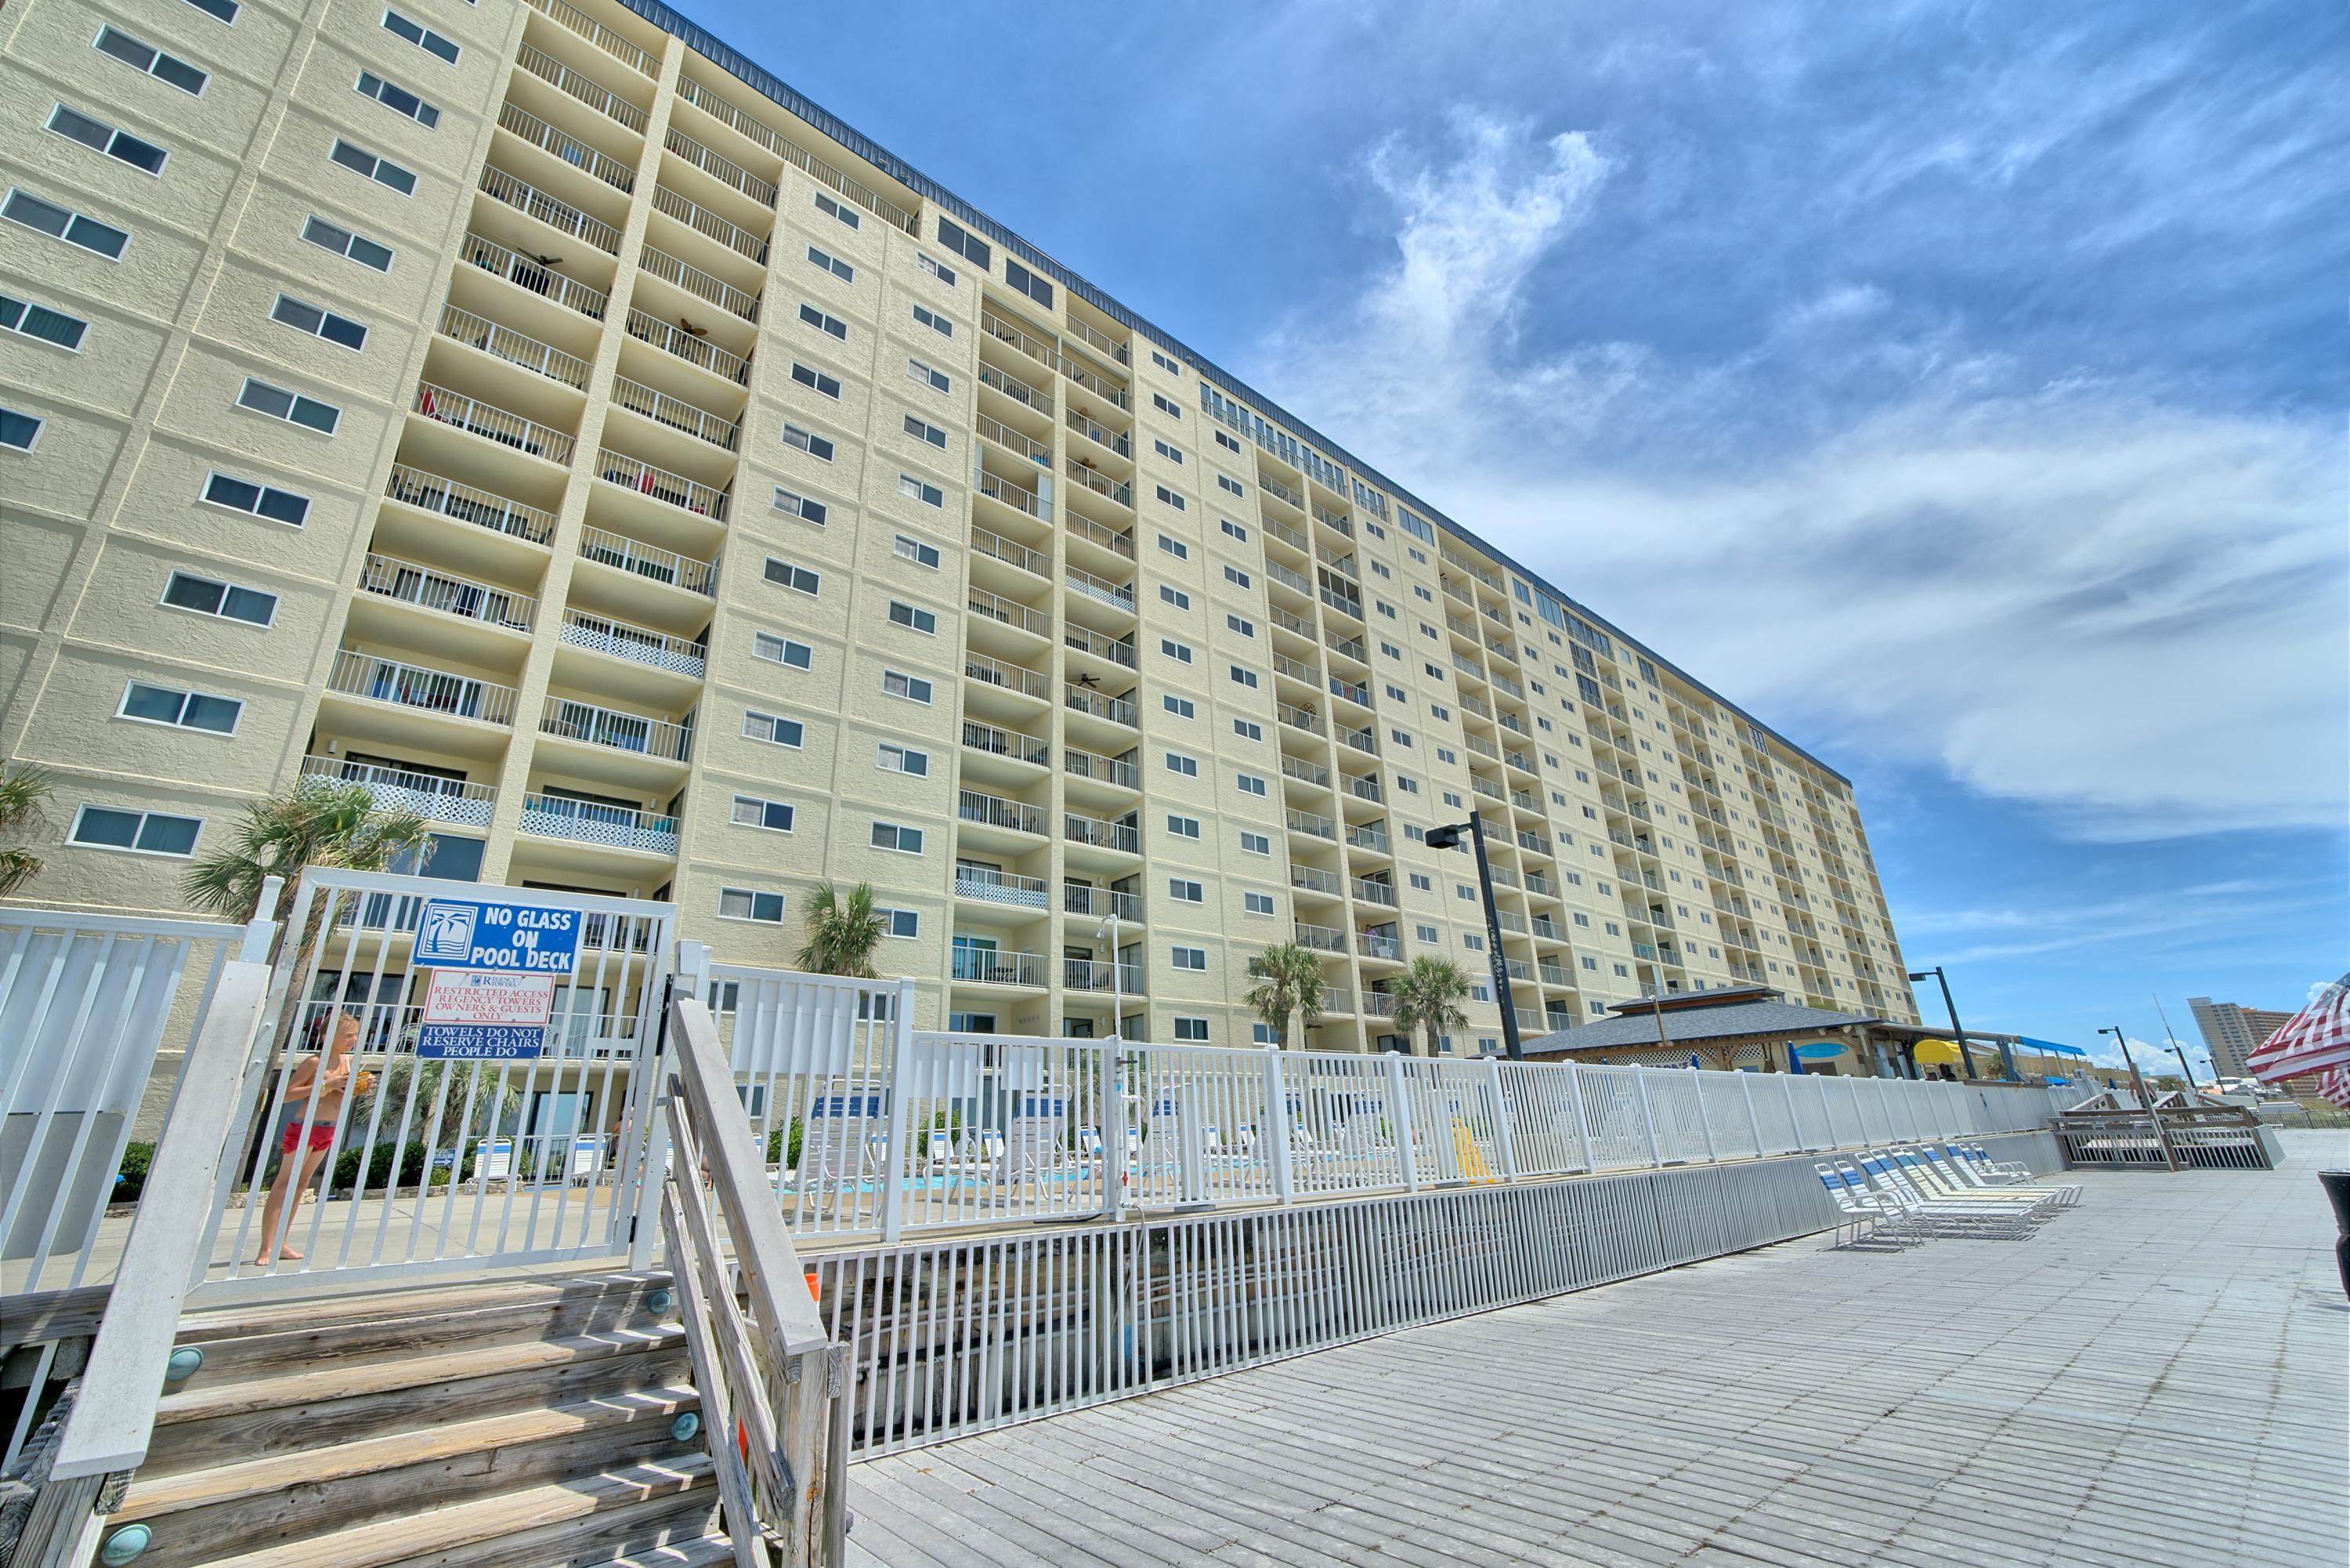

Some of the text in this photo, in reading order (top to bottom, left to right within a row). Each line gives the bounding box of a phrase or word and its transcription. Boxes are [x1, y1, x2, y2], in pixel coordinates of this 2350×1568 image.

[485, 907, 571, 930] NO GLASS
[512, 930, 539, 948] ON
[471, 947, 571, 970] POOL DECK
[482, 976, 517, 985] REGENCY
[434, 987, 548, 999] RESTRICTED ACCESS
[439, 995, 494, 1004] REGENCY
[436, 1003, 486, 1011] OWNERS
[425, 1027, 540, 1038] TOWELS DO NOT
[421, 1036, 539, 1047] RESERVE CHAIRS
[443, 1046, 517, 1057] PEOPLE DO
